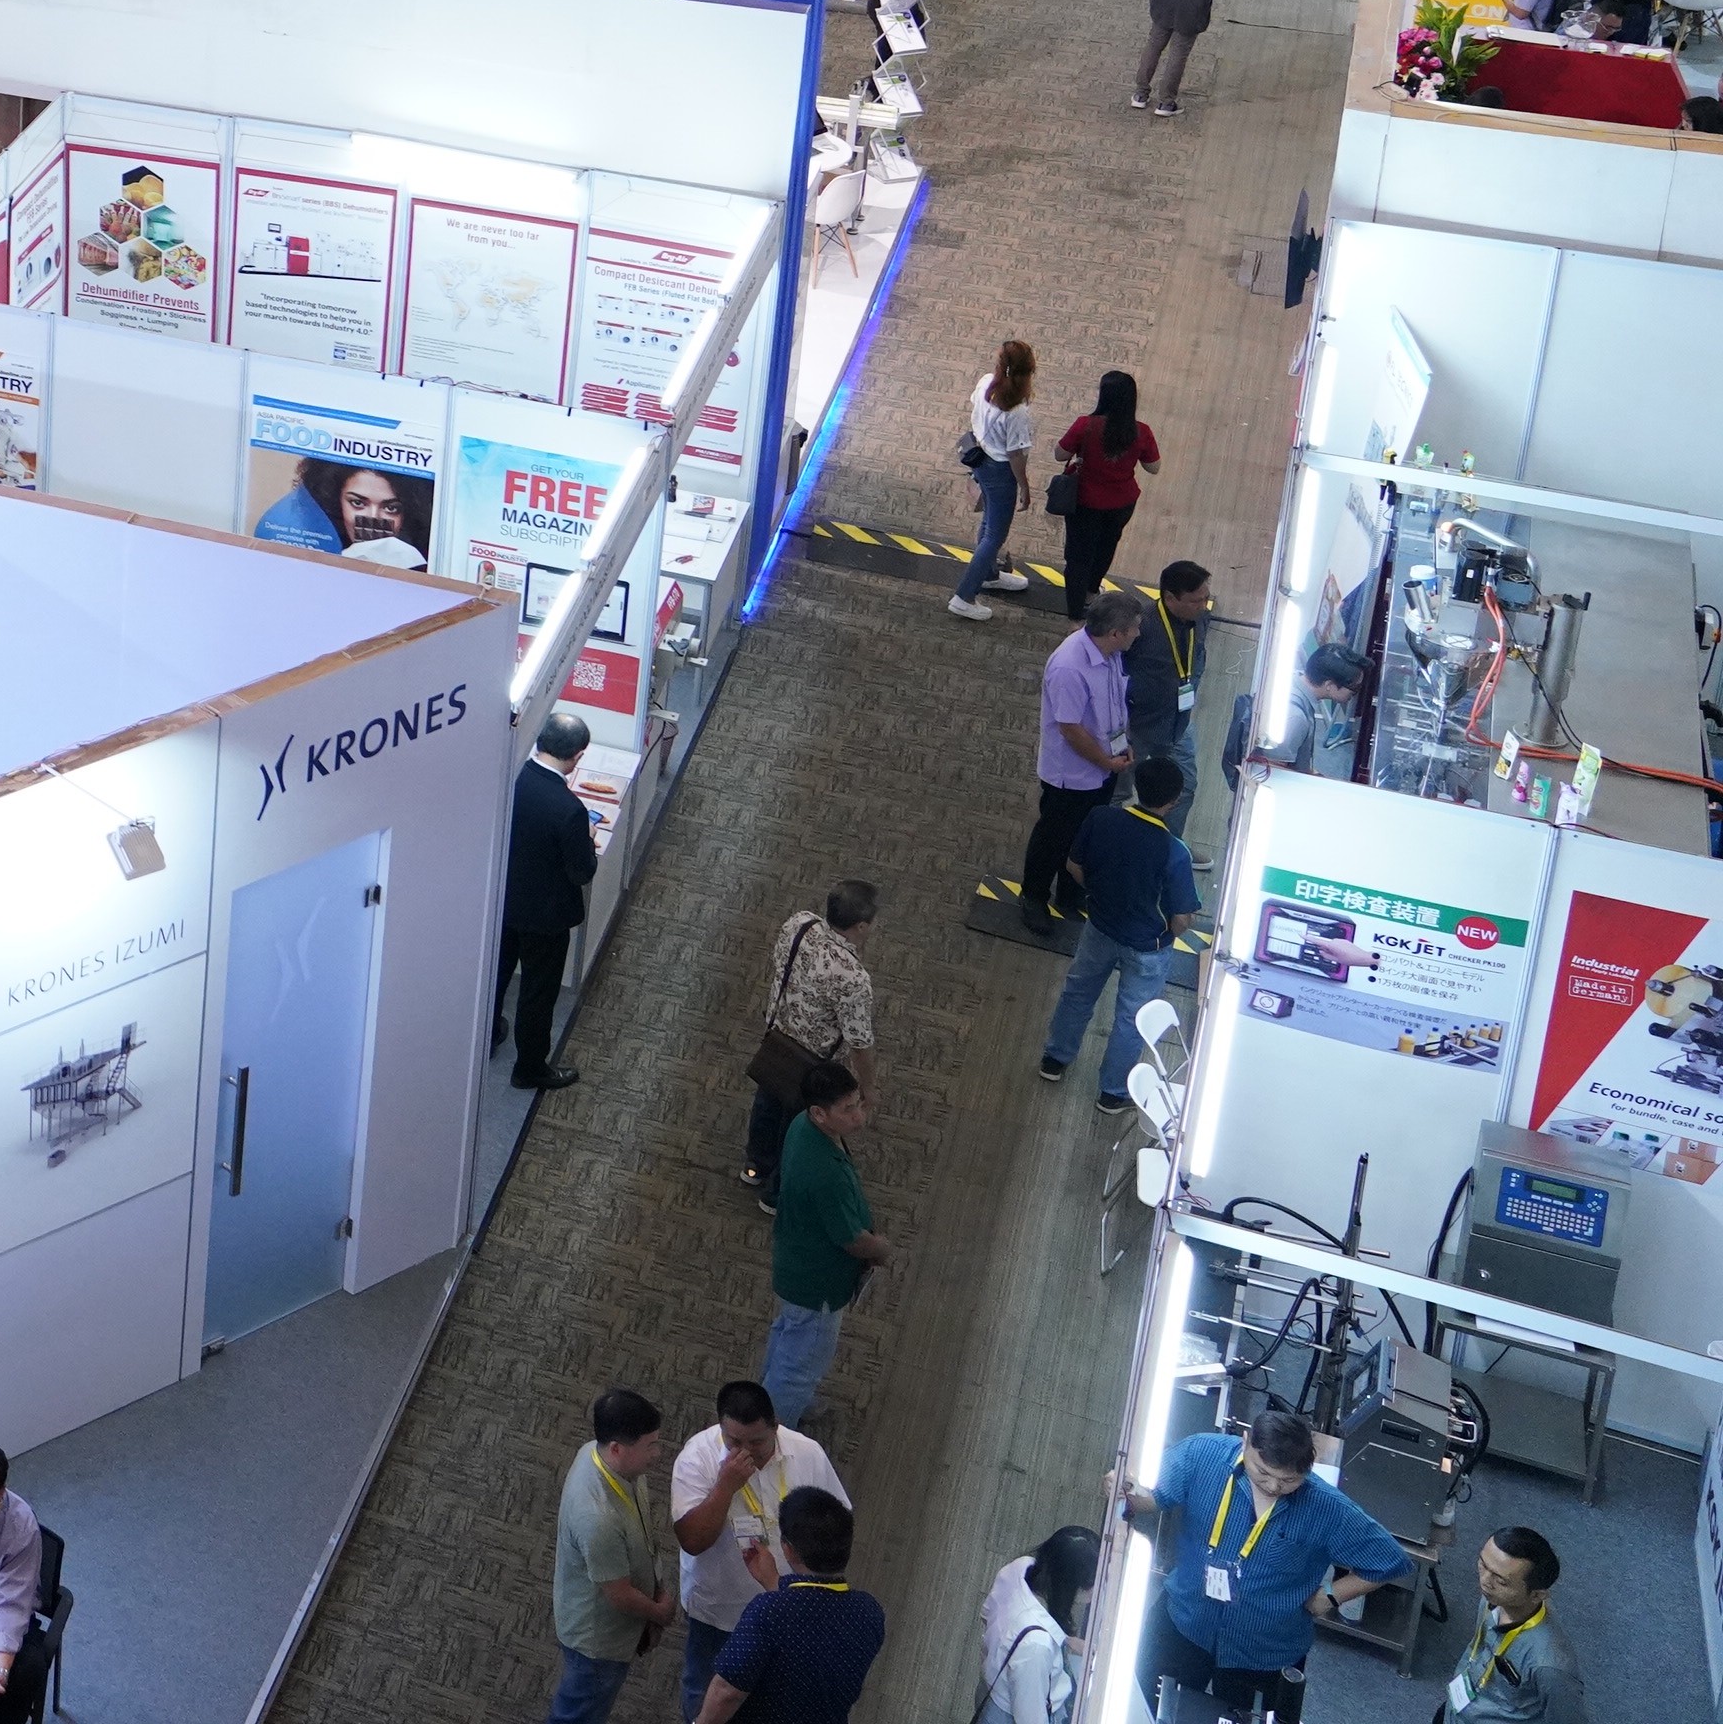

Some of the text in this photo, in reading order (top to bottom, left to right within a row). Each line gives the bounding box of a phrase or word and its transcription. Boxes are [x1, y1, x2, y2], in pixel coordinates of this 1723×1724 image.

[594, 266, 685, 290] Compact Desiccant
[81, 282, 200, 310] Dehumidifier Prevents
[318, 303, 357, 315] tomorrow
[256, 419, 433, 468] FOOD INDUSTRY
[531, 463, 585, 482] GET YOUR
[503, 470, 608, 521] FREE
[502, 507, 593, 537] MAGAZIN
[306, 684, 468, 784] KRONES
[1295, 879, 1441, 929] 印字検査装置
[1373, 933, 1412, 951] KGK
[1456, 924, 1498, 943] NEW
[7, 918, 185, 1007] KRONES IZUMI
[1448, 953, 1481, 966] CHECKER
[1570, 955, 1640, 977] Industrial
[1572, 985, 1629, 1004] Germany
[1573, 977, 1627, 995] Made in
[1588, 1082, 1700, 1118] Economical
[1629, 1106, 1719, 1136] bundle, case and
